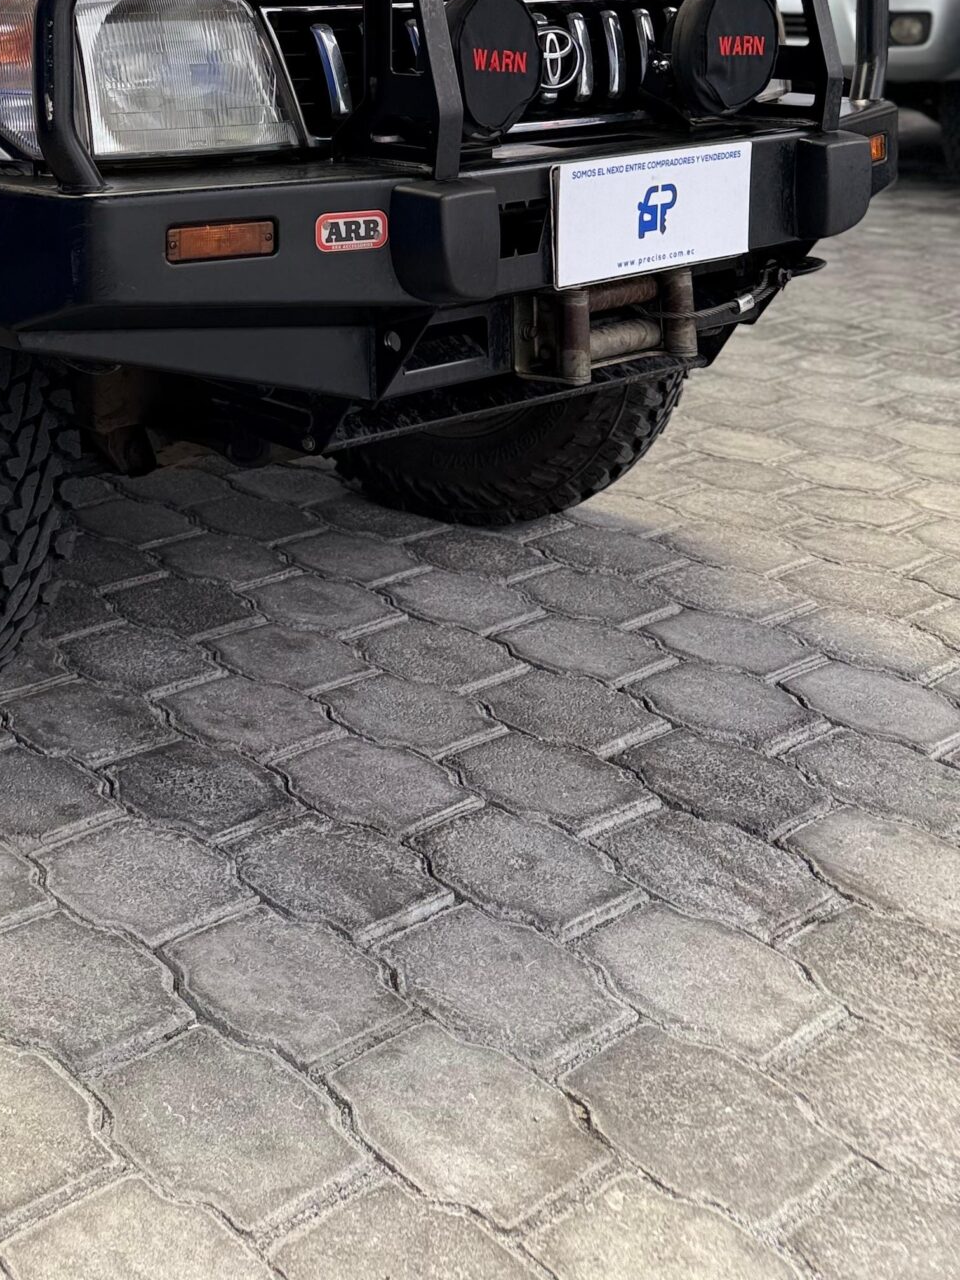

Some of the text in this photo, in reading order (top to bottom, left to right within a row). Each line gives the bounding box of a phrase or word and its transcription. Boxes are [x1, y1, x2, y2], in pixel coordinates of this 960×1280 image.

[718, 35, 766, 56] WARN
[473, 48, 528, 73] WARN
[572, 150, 742, 180] SOMOS EL NEXO ENTRE COMPRADORES Y VENDEDORES
[325, 219, 380, 243] ARB
